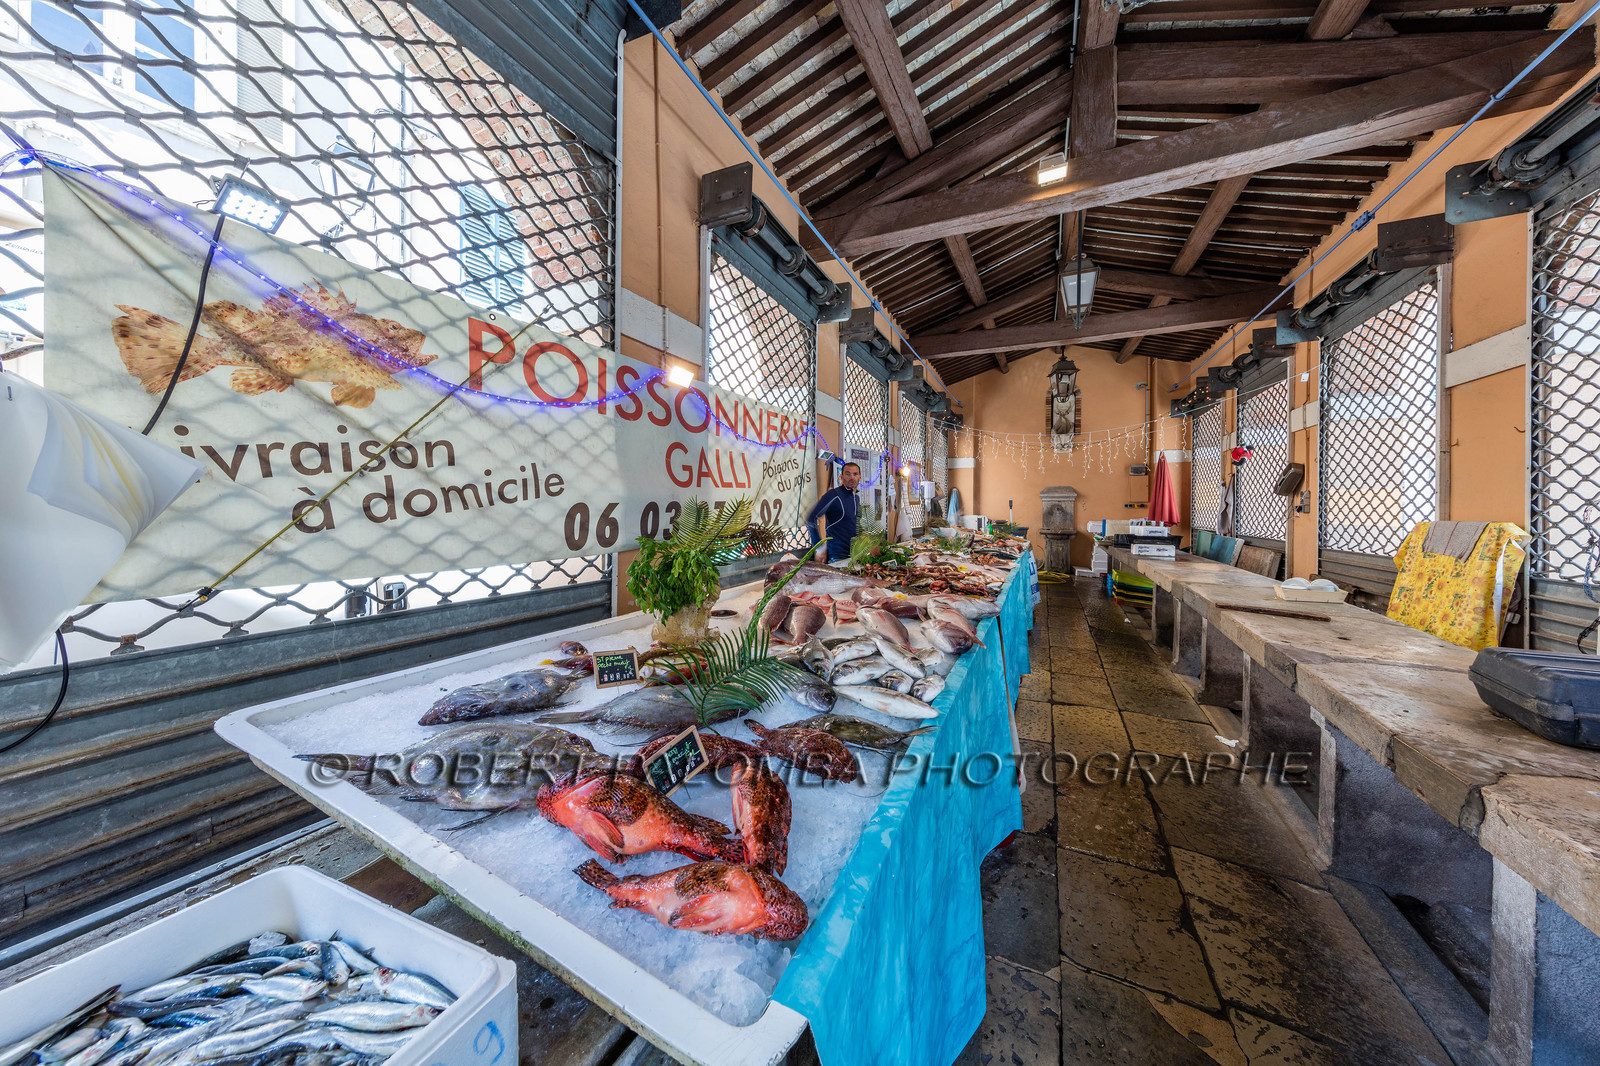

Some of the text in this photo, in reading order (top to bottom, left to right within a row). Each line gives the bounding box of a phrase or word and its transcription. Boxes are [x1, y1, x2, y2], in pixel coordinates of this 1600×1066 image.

[467, 316, 808, 450] POISSONNERIE
[173, 424, 456, 484] vraison
[665, 441, 751, 489] GALLI
[291, 462, 565, 534] à domicile
[777, 474, 792, 493] du
[564, 502, 620, 552] 06
[640, 500, 682, 541] 03
[760, 498, 783, 528] 02
